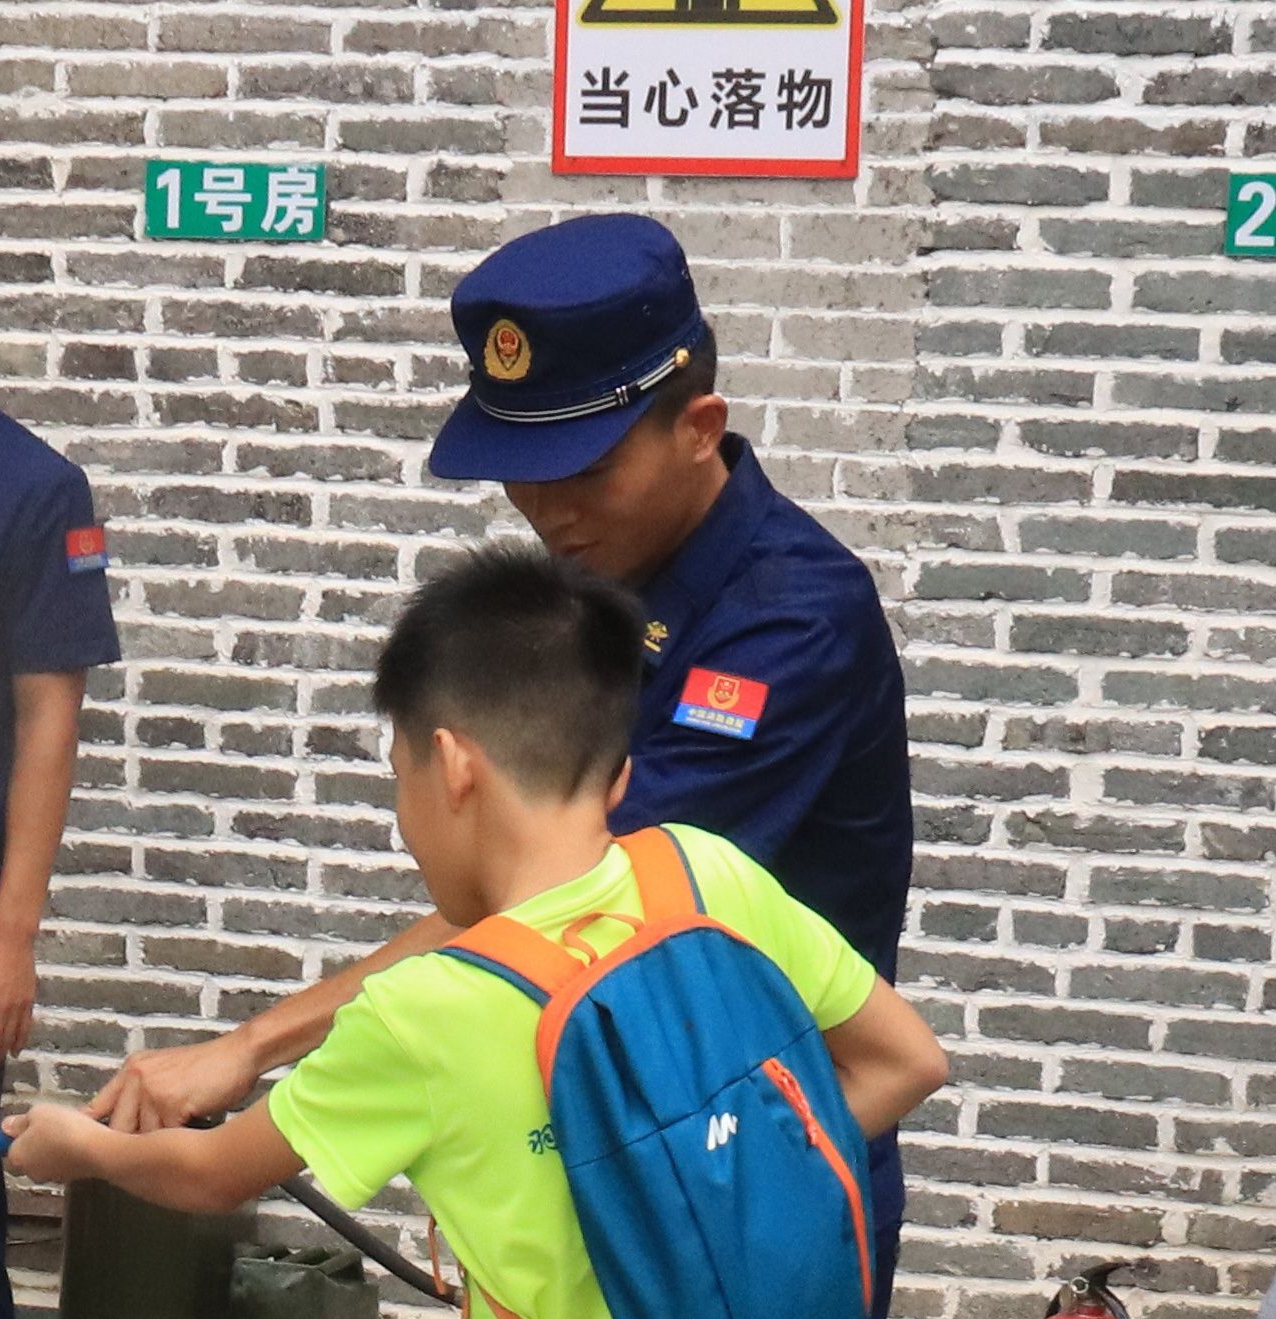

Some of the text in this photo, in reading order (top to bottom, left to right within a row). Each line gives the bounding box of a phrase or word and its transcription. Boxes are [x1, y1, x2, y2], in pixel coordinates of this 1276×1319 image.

[579, 66, 833, 131] 当心落物
[156, 166, 319, 235] 1号房
[1234, 180, 1276, 248] 2
